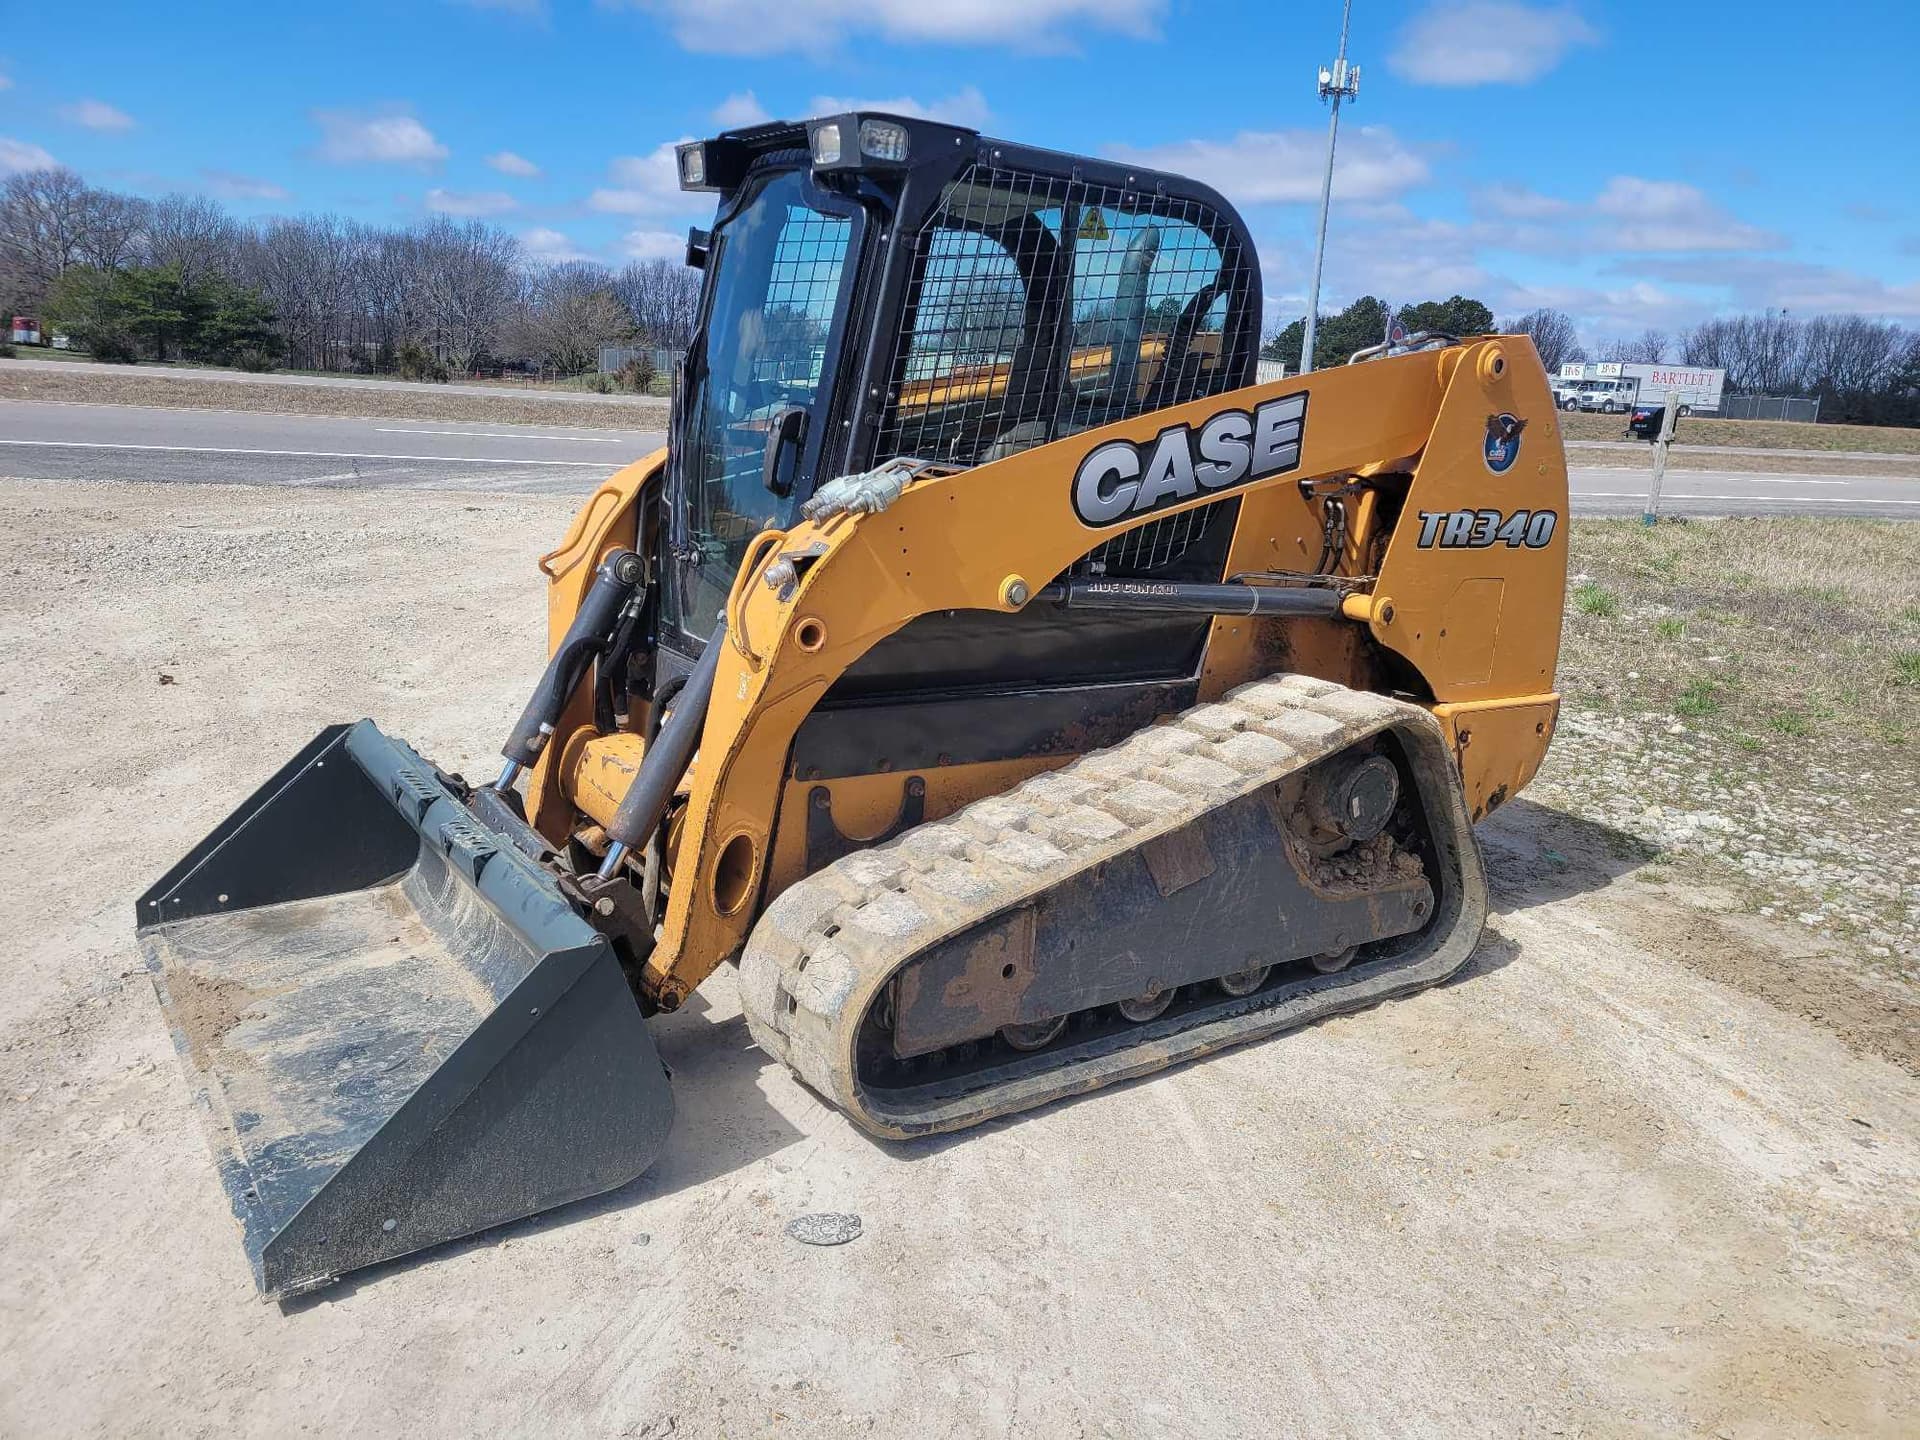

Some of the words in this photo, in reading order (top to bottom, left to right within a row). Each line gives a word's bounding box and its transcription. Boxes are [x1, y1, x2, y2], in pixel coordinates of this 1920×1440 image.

[1652, 371, 1713, 386] BARTLETT
[1073, 392, 1307, 526] CASE
[1418, 510, 1558, 548] TR340
